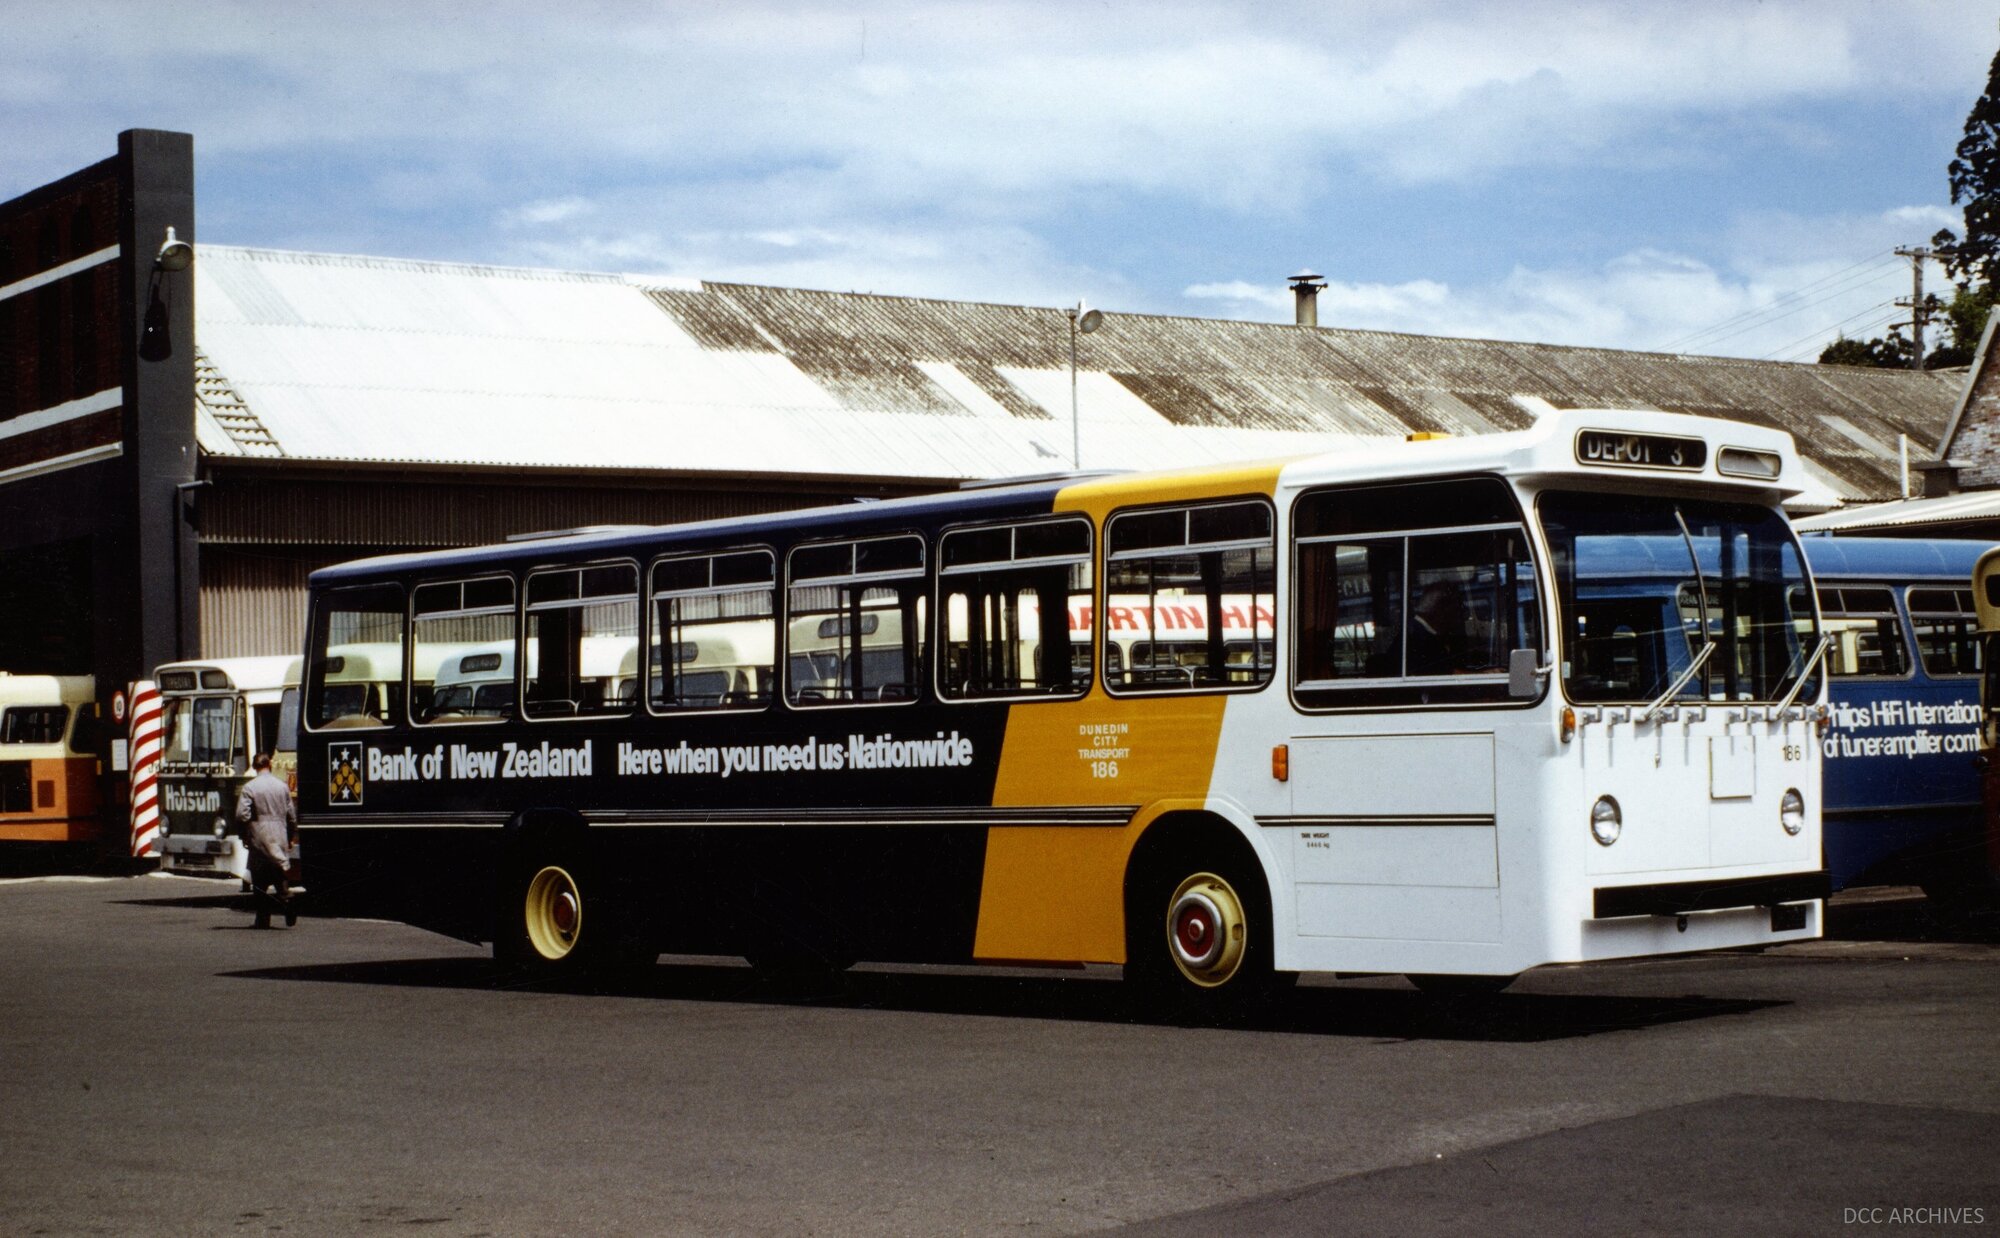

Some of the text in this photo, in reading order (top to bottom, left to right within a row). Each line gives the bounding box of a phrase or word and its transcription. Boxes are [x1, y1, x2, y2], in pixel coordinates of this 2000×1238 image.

[1828, 701, 1872, 732] hilips
[1079, 723, 1128, 735] DUNEDIN
[1093, 735, 1118, 746] CITY
[1823, 732, 1839, 758] of
[367, 739, 593, 781] Bank of New Zealand
[618, 742, 663, 775] Here
[664, 740, 719, 774] when
[721, 745, 760, 778] you
[763, 736, 816, 771] need
[1078, 748, 1130, 759] TRANSPORT
[1782, 745, 1800, 761] 186
[1091, 761, 1118, 778] 186
